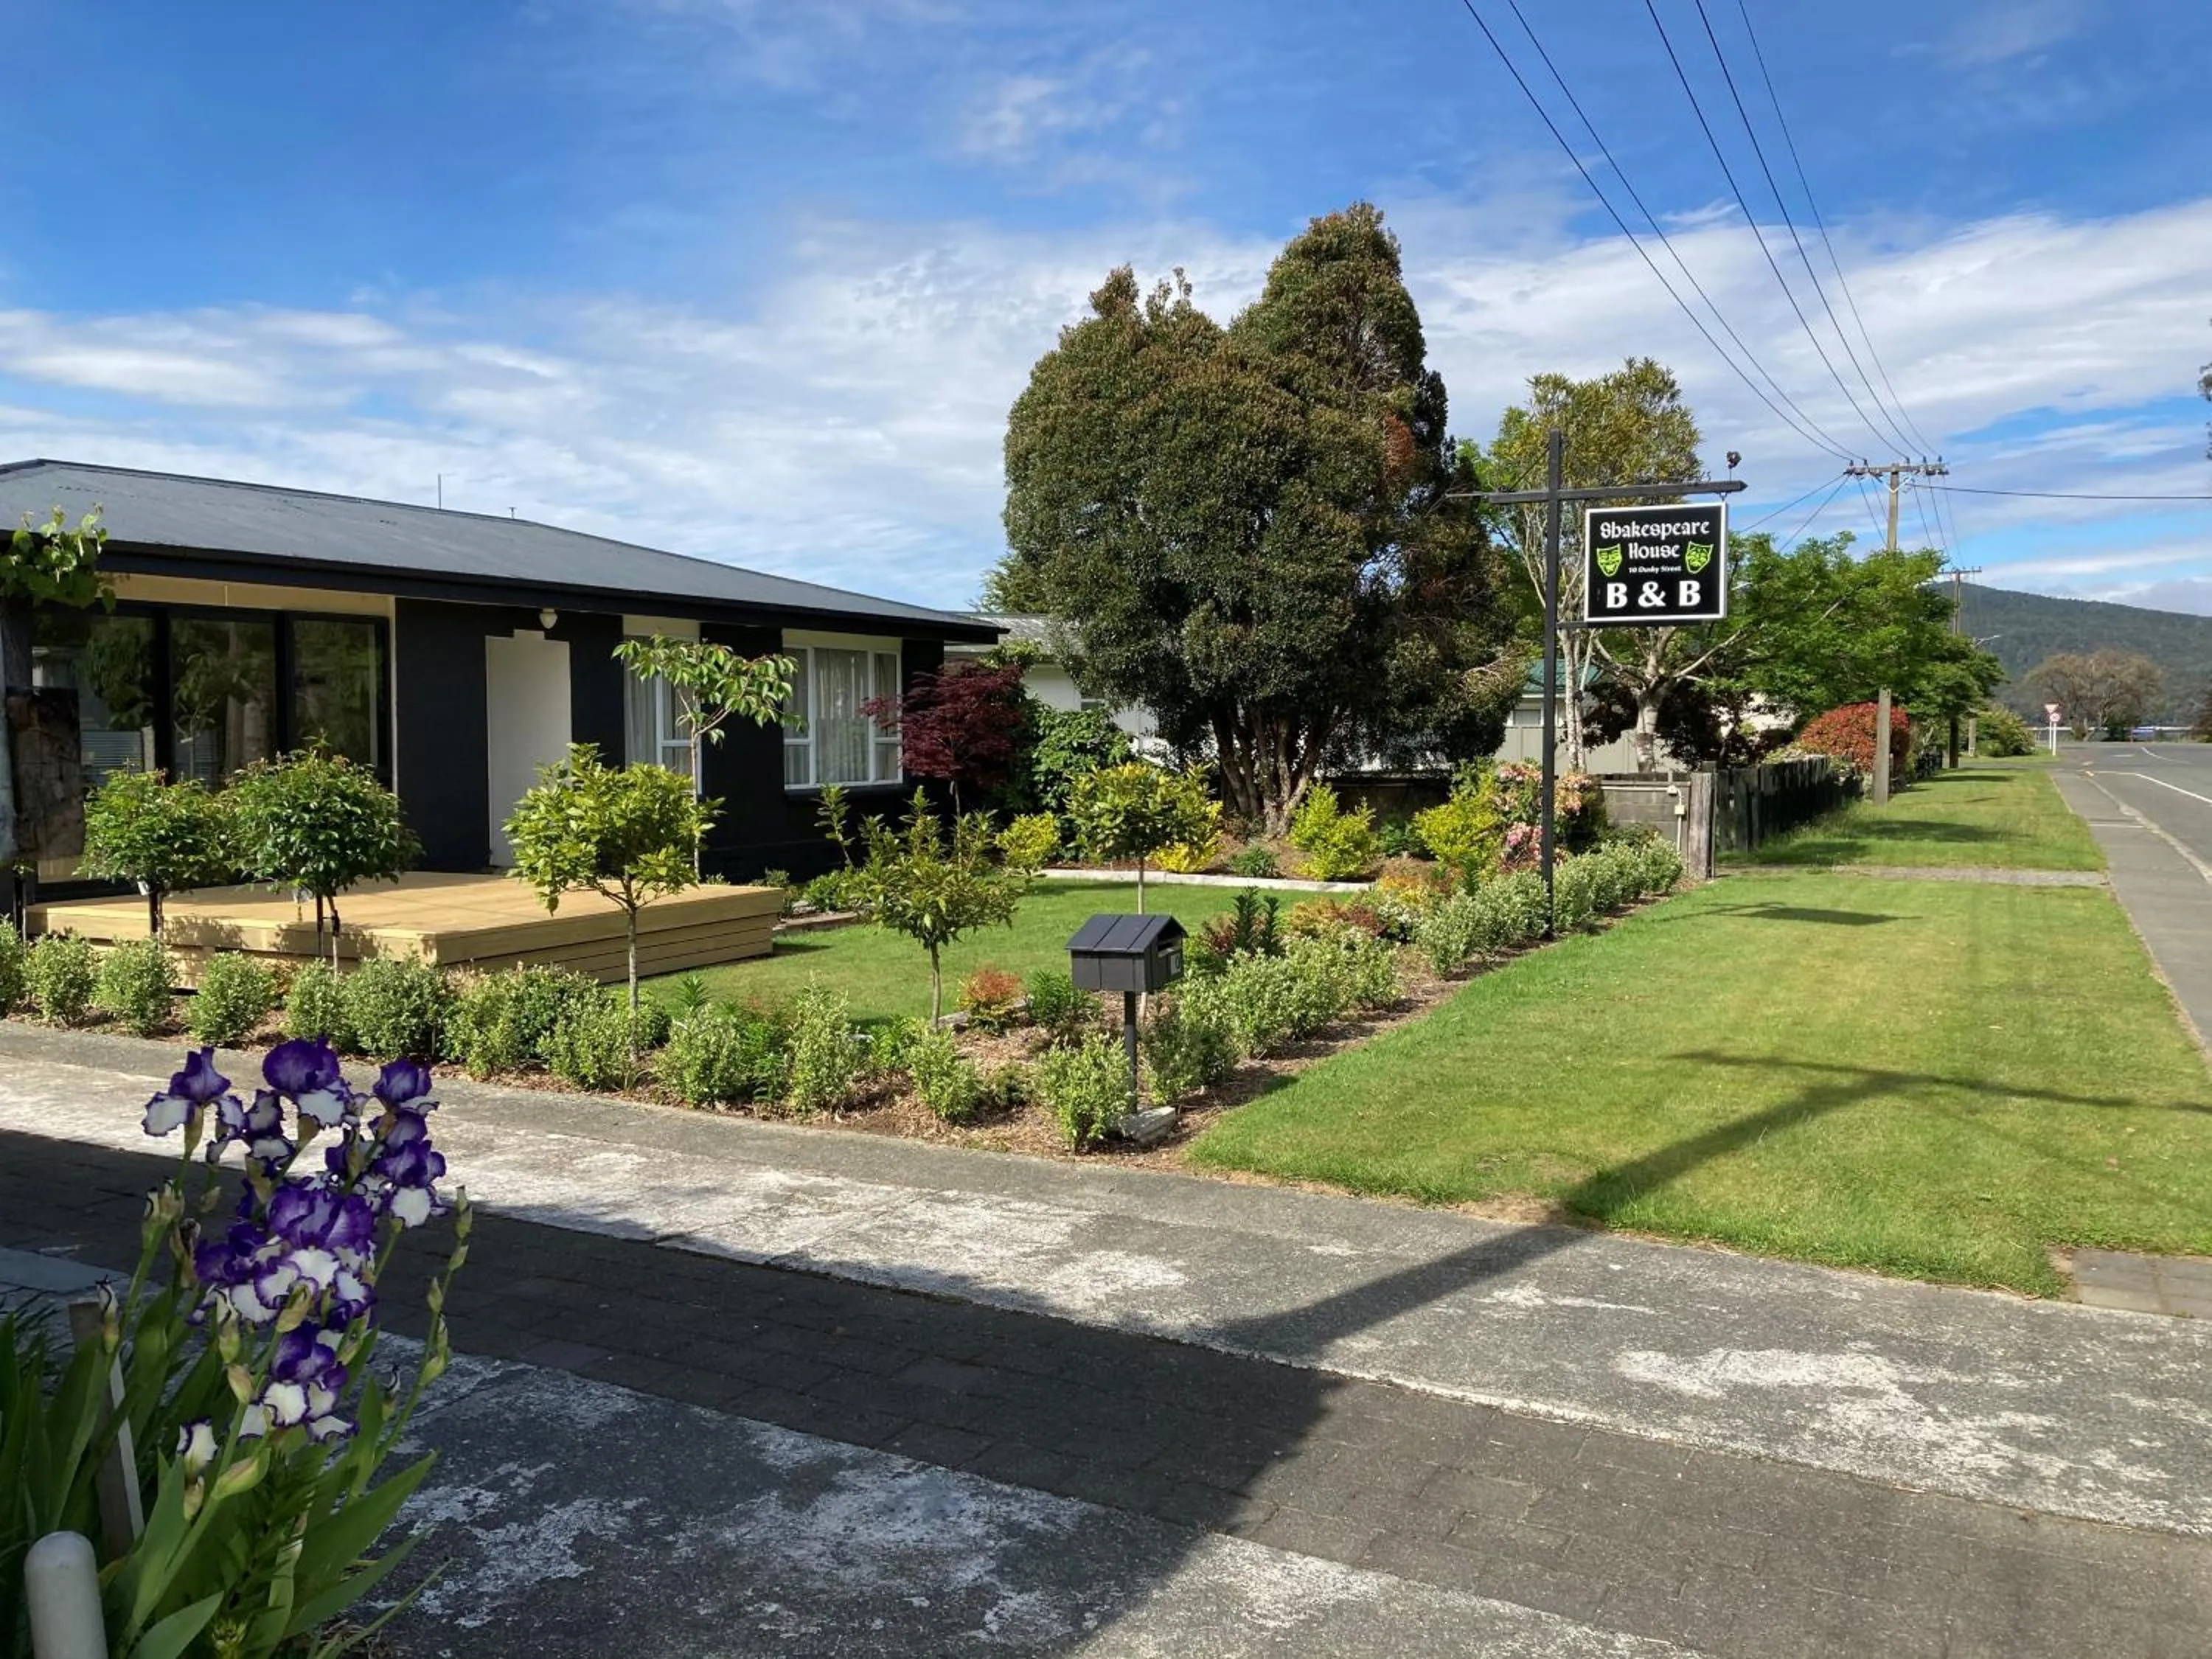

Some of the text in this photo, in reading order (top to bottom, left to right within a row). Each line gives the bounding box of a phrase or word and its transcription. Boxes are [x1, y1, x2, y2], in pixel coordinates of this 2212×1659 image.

[1600, 521, 1710, 540] Shakespeare
[1628, 542, 1680, 559] House
[1607, 580, 1700, 608] B & B
